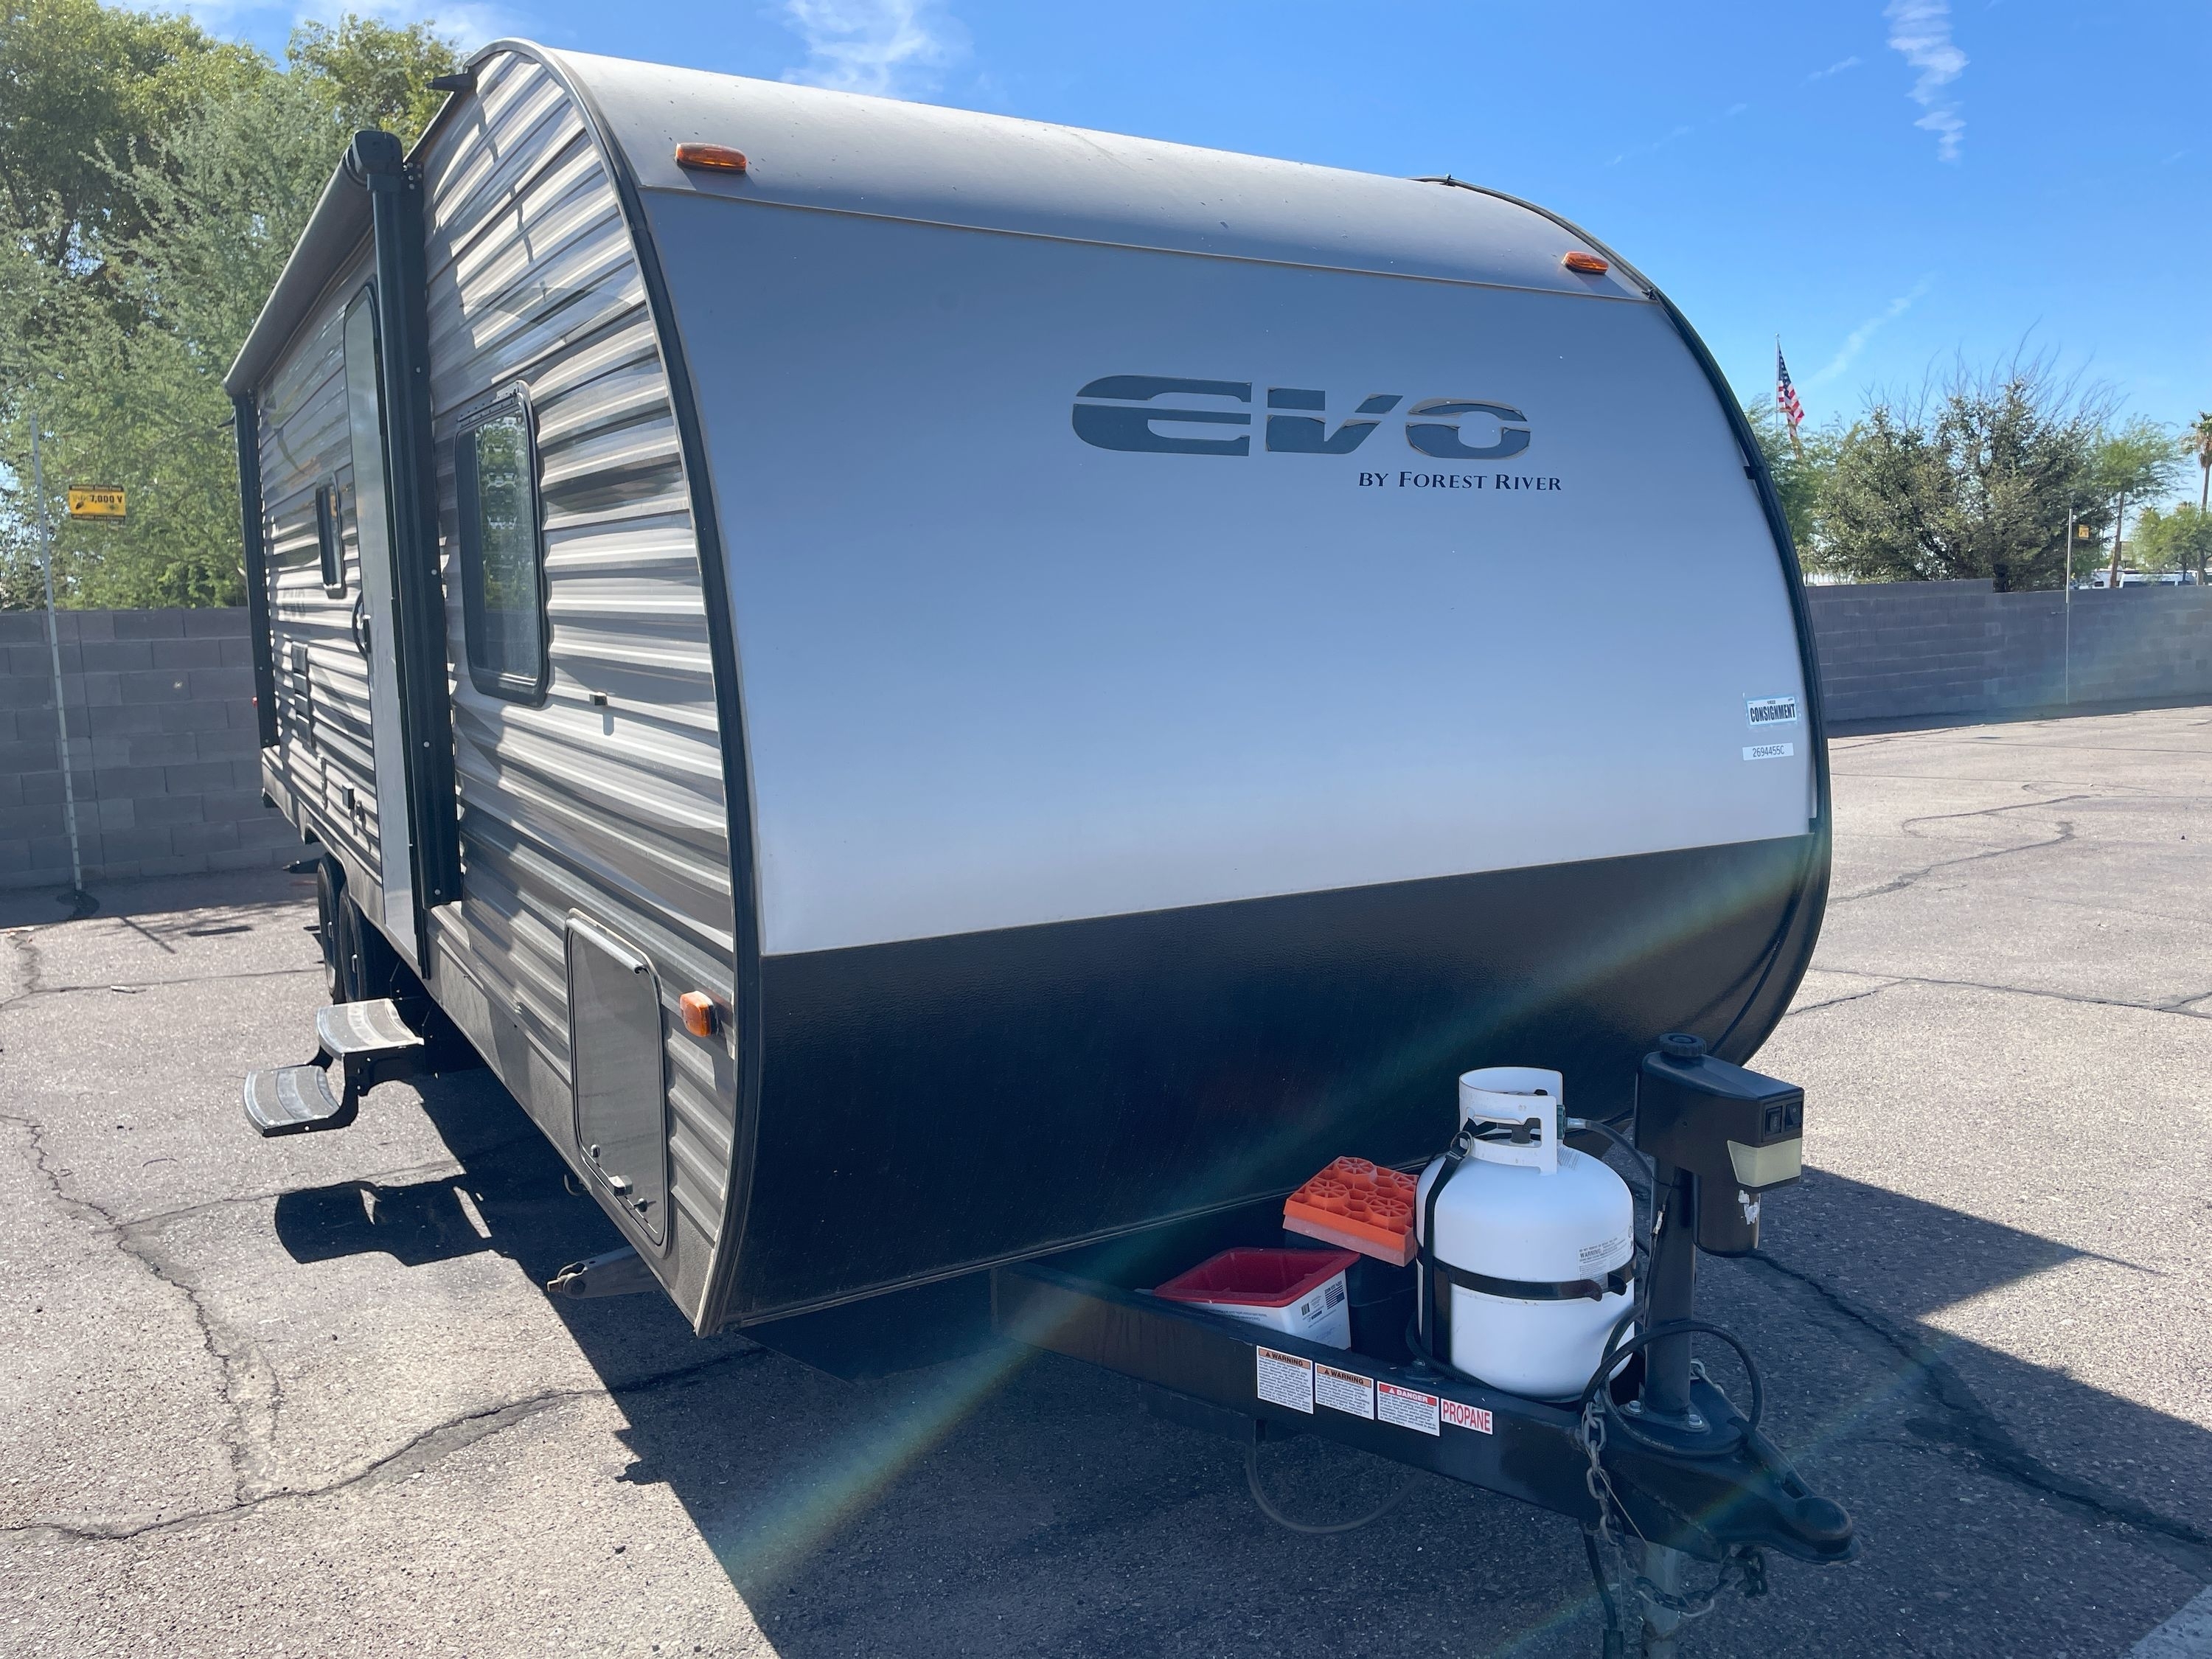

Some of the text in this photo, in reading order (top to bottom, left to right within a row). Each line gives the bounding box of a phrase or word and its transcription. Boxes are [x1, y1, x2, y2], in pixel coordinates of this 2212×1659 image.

[1359, 472, 1388, 487] BY
[90, 495, 114, 504] 7,000
[1750, 703, 1795, 723] CONSIGNMENT
[1752, 745, 1785, 757] 2694455C
[1579, 1248, 1601, 1258] WARNING
[1272, 1352, 1303, 1366] WARNING
[1331, 1369, 1364, 1385] WARNING
[1397, 1389, 1428, 1403] DANGER
[1443, 1401, 1491, 1432] PROPANE
